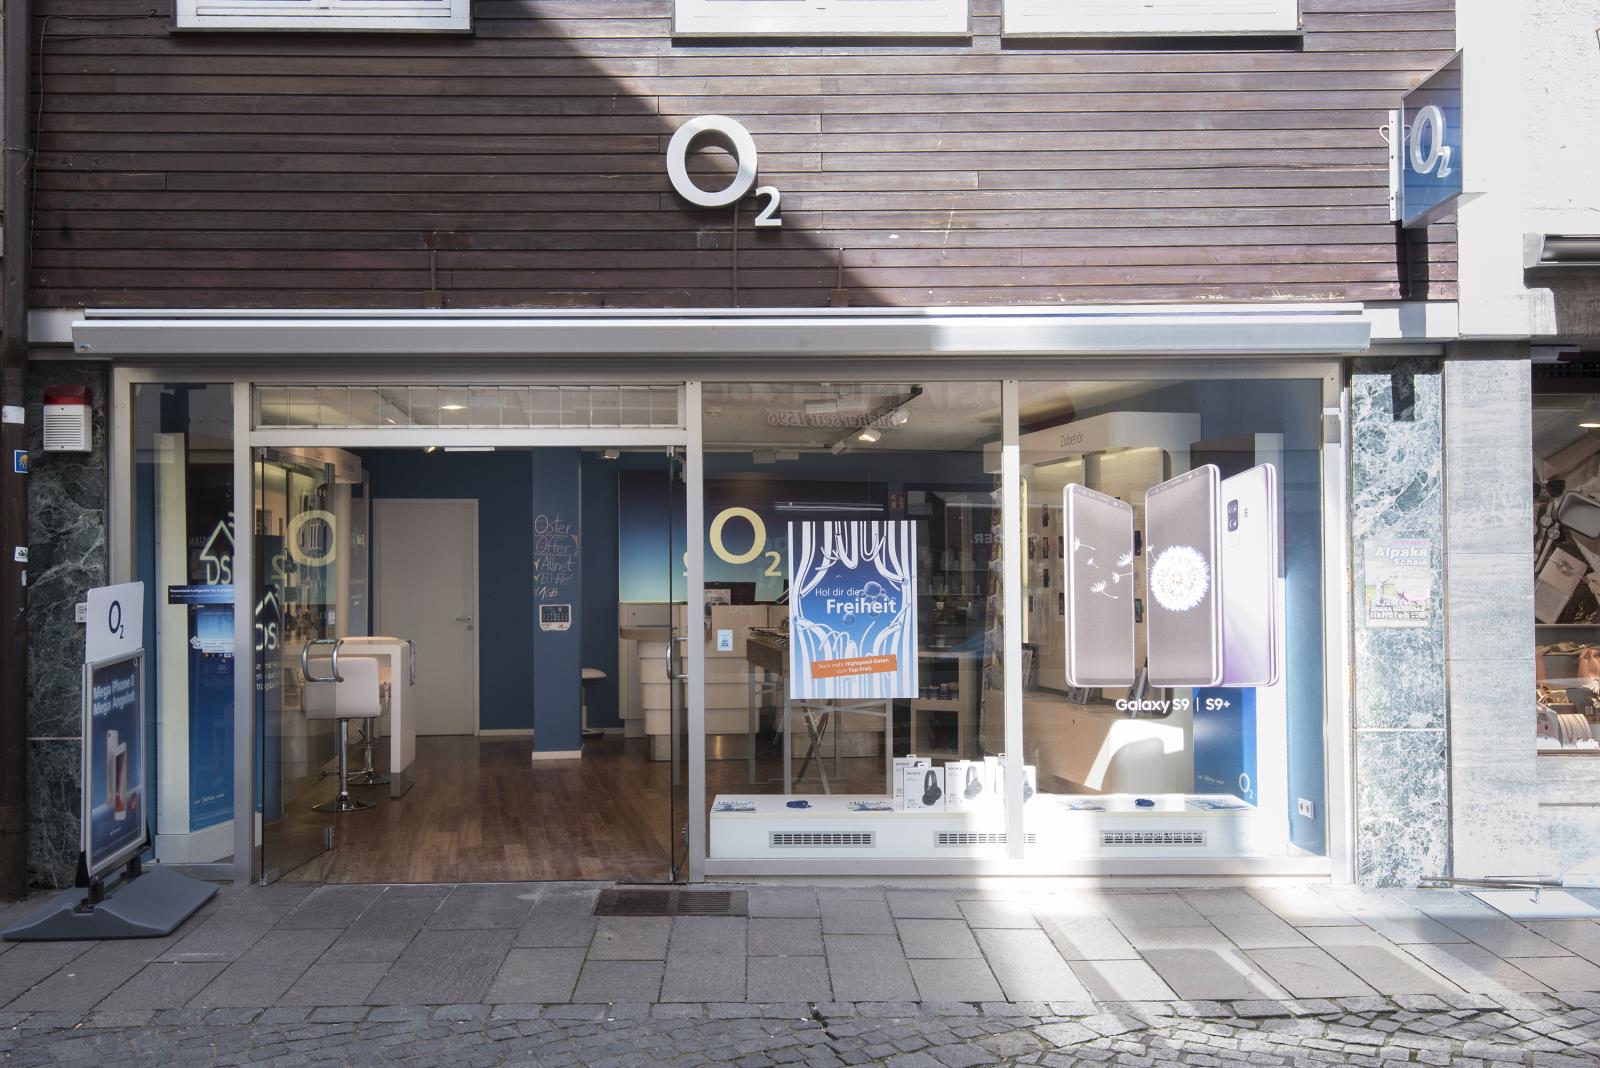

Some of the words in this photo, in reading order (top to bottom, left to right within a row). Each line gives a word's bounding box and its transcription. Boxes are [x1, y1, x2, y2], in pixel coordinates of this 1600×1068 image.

[534, 512, 571, 533] Oster
[1375, 546, 1427, 559] Alpaka
[815, 587, 831, 597] Hol
[833, 587, 844, 597] dir
[846, 587, 860, 597] die
[826, 597, 897, 614] Freiheit
[93, 685, 112, 700] Mega
[93, 701, 112, 716] Mega
[1115, 698, 1170, 714] Galaxy
[1172, 697, 1190, 711] S9
[1205, 697, 1231, 711] S9+
